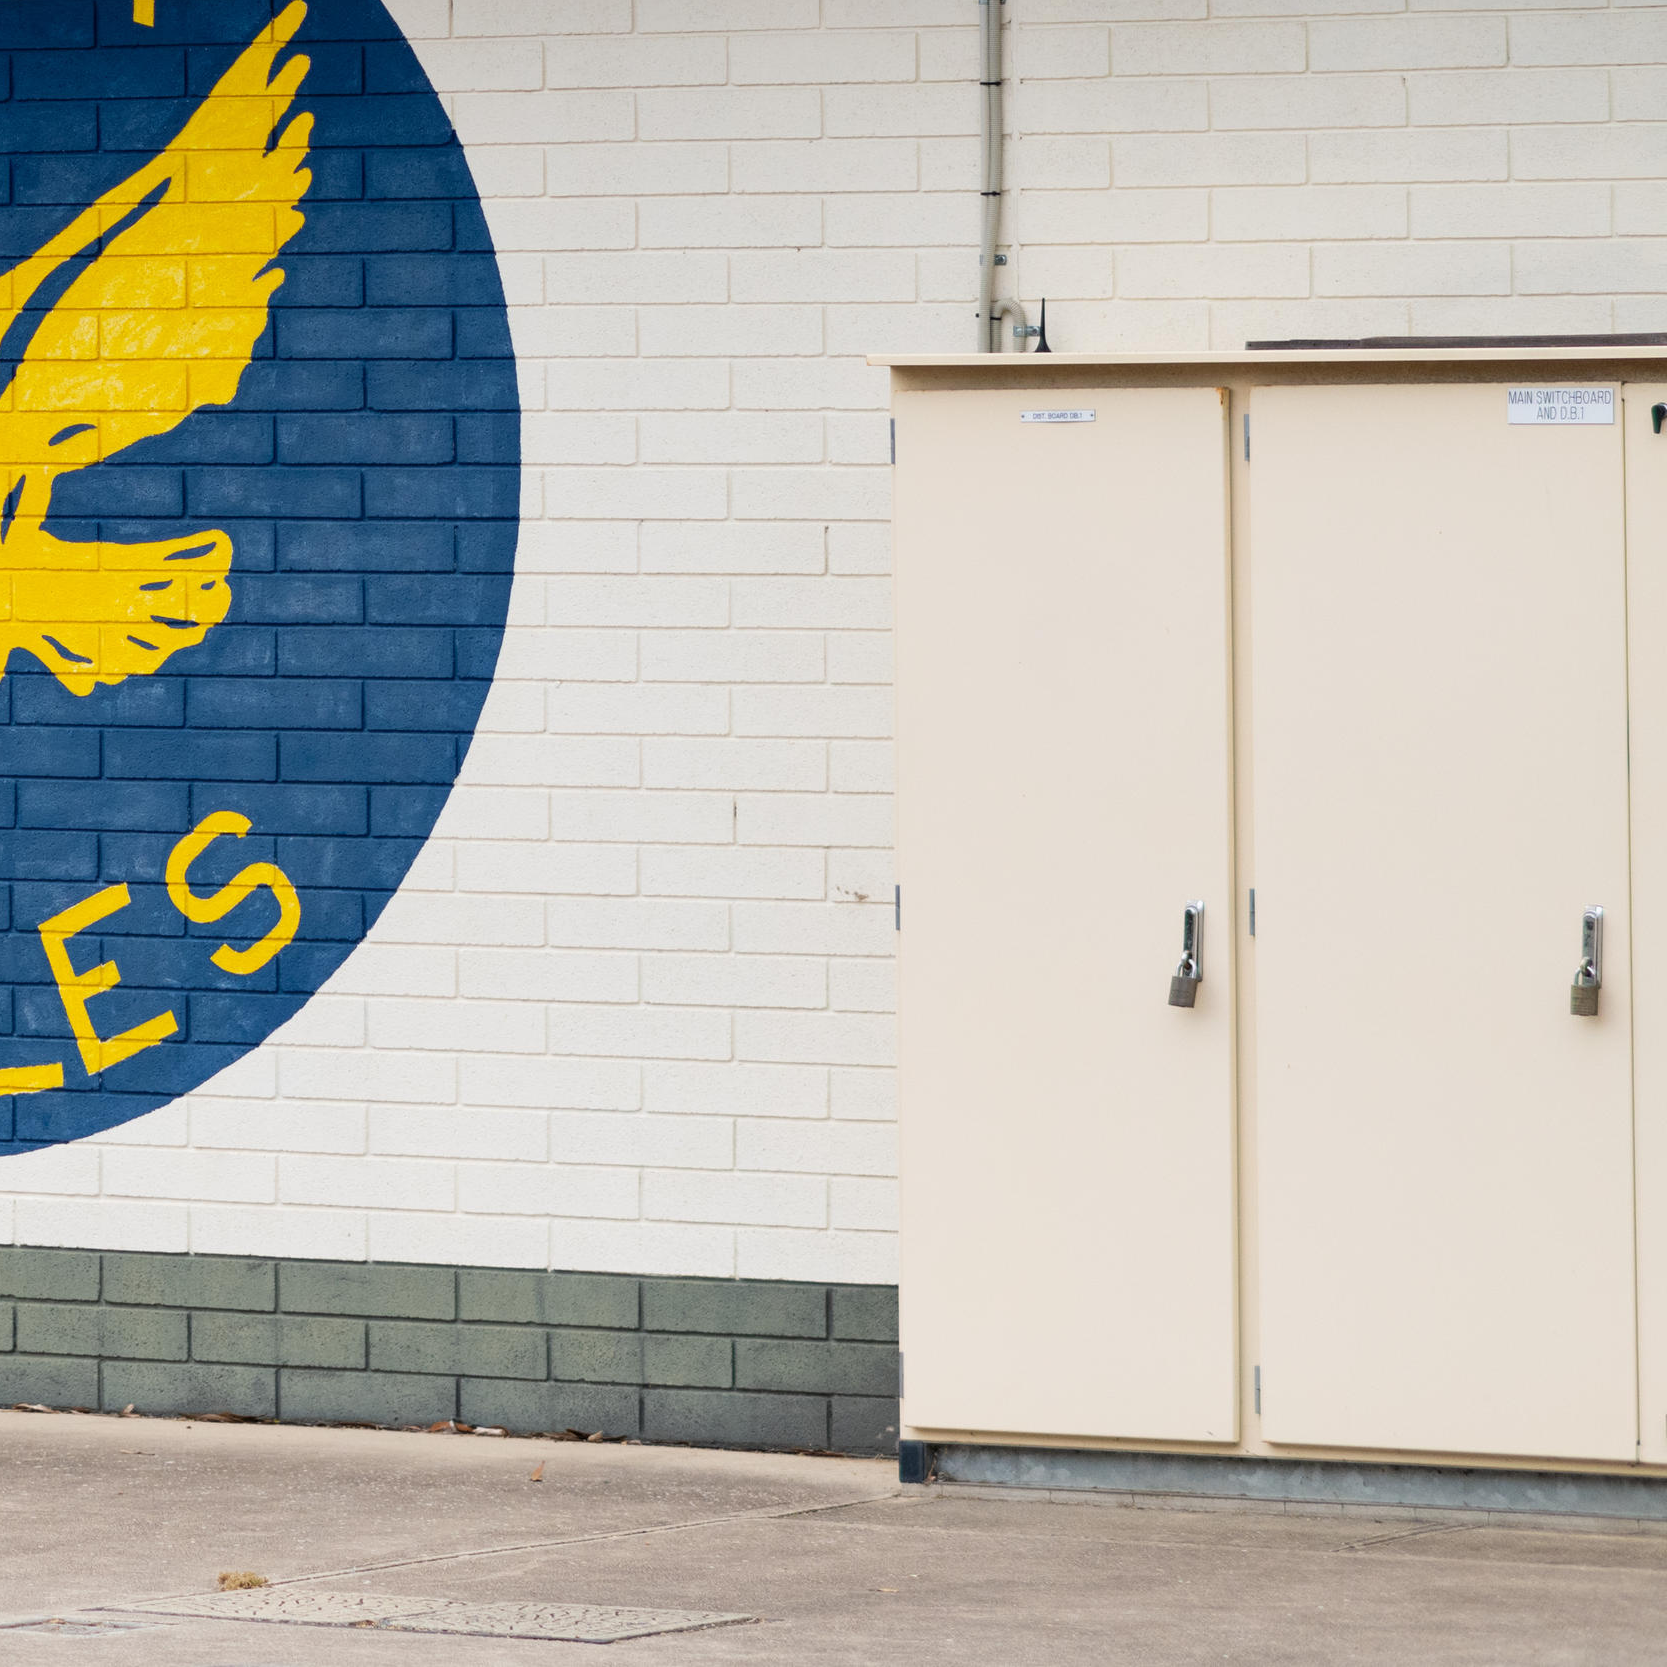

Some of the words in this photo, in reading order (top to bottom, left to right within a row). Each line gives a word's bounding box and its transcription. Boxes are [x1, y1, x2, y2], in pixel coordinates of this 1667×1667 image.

[1508, 390, 1533, 405] MAIN
[1536, 390, 1612, 405] SWITCHBOARD
[1047, 412, 1068, 420] BOARD
[1537, 406, 1557, 420] AND
